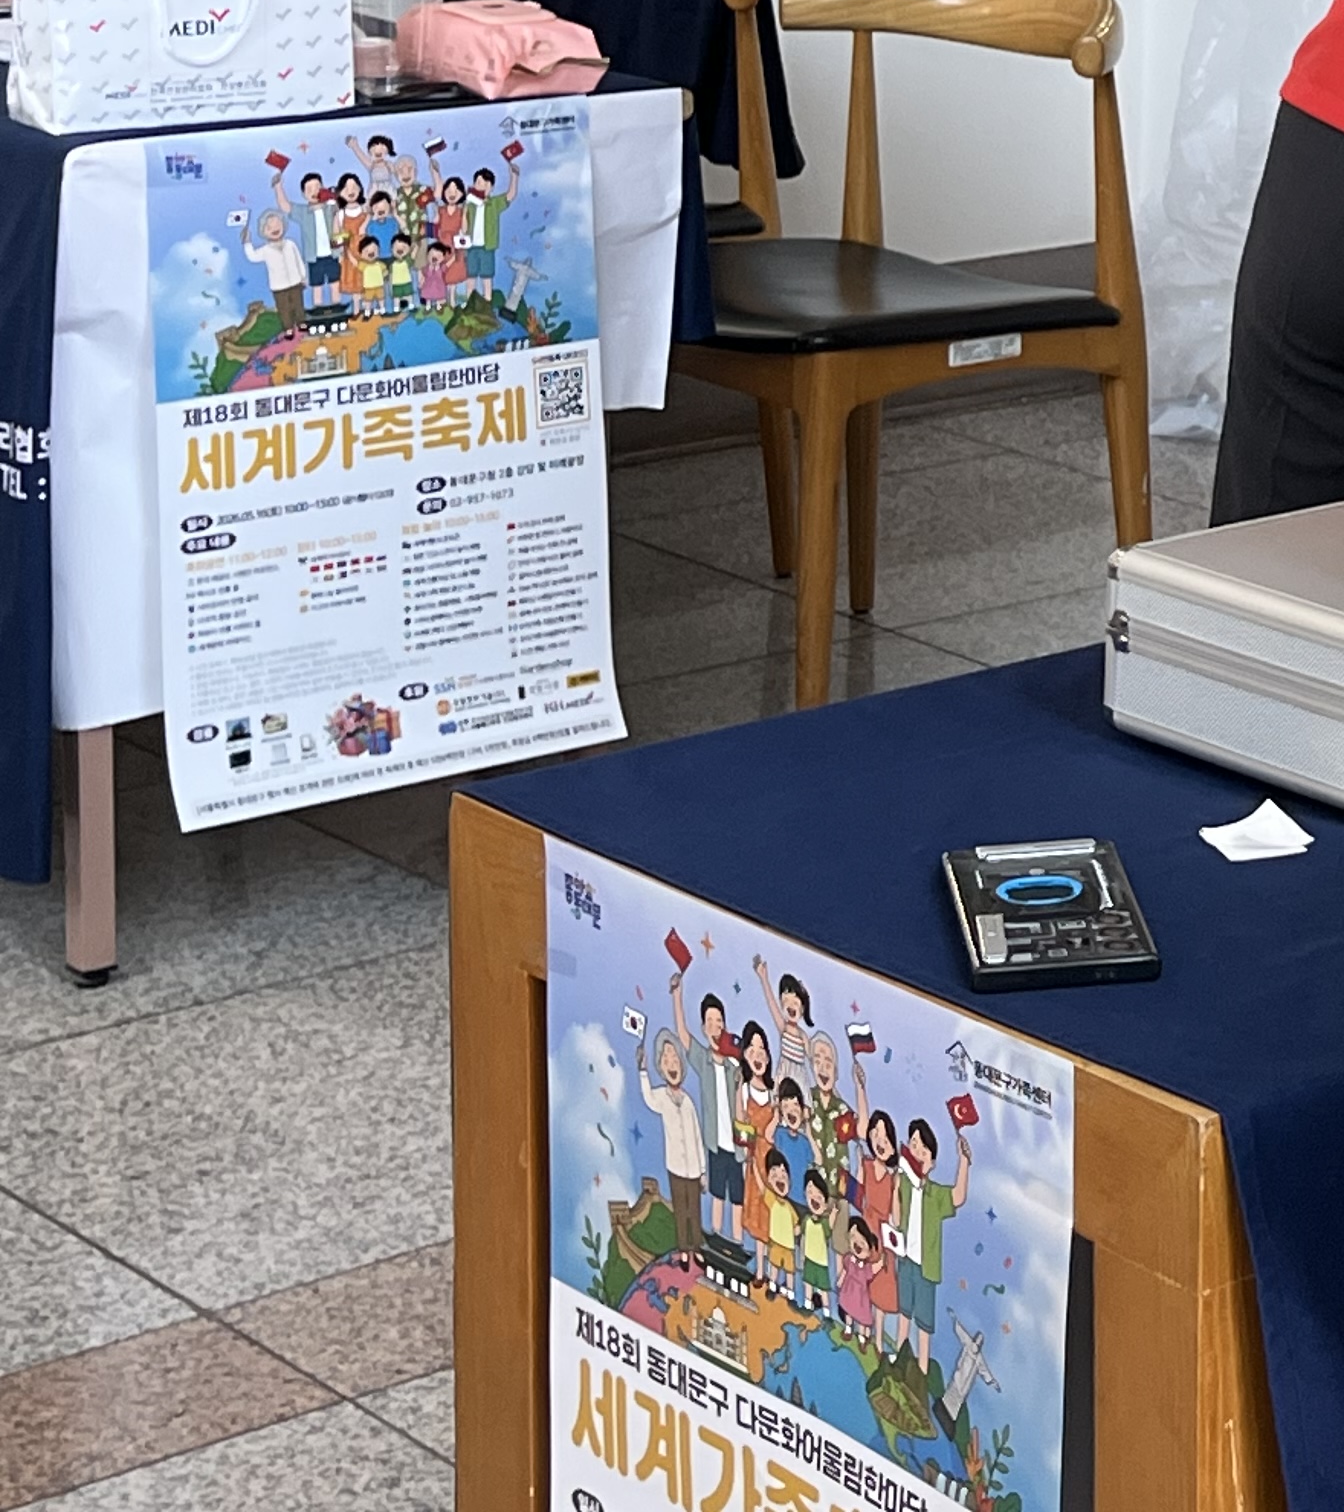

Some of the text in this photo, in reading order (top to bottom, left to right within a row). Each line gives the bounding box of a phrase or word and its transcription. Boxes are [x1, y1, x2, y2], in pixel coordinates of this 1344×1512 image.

[179, 384, 528, 494] 세계가족축제
[182, 362, 500, 429] 제18회 동대문구 다문화어울림한마당
[575, 1305, 641, 1374] 제18회
[646, 1344, 730, 1419] 동대문구
